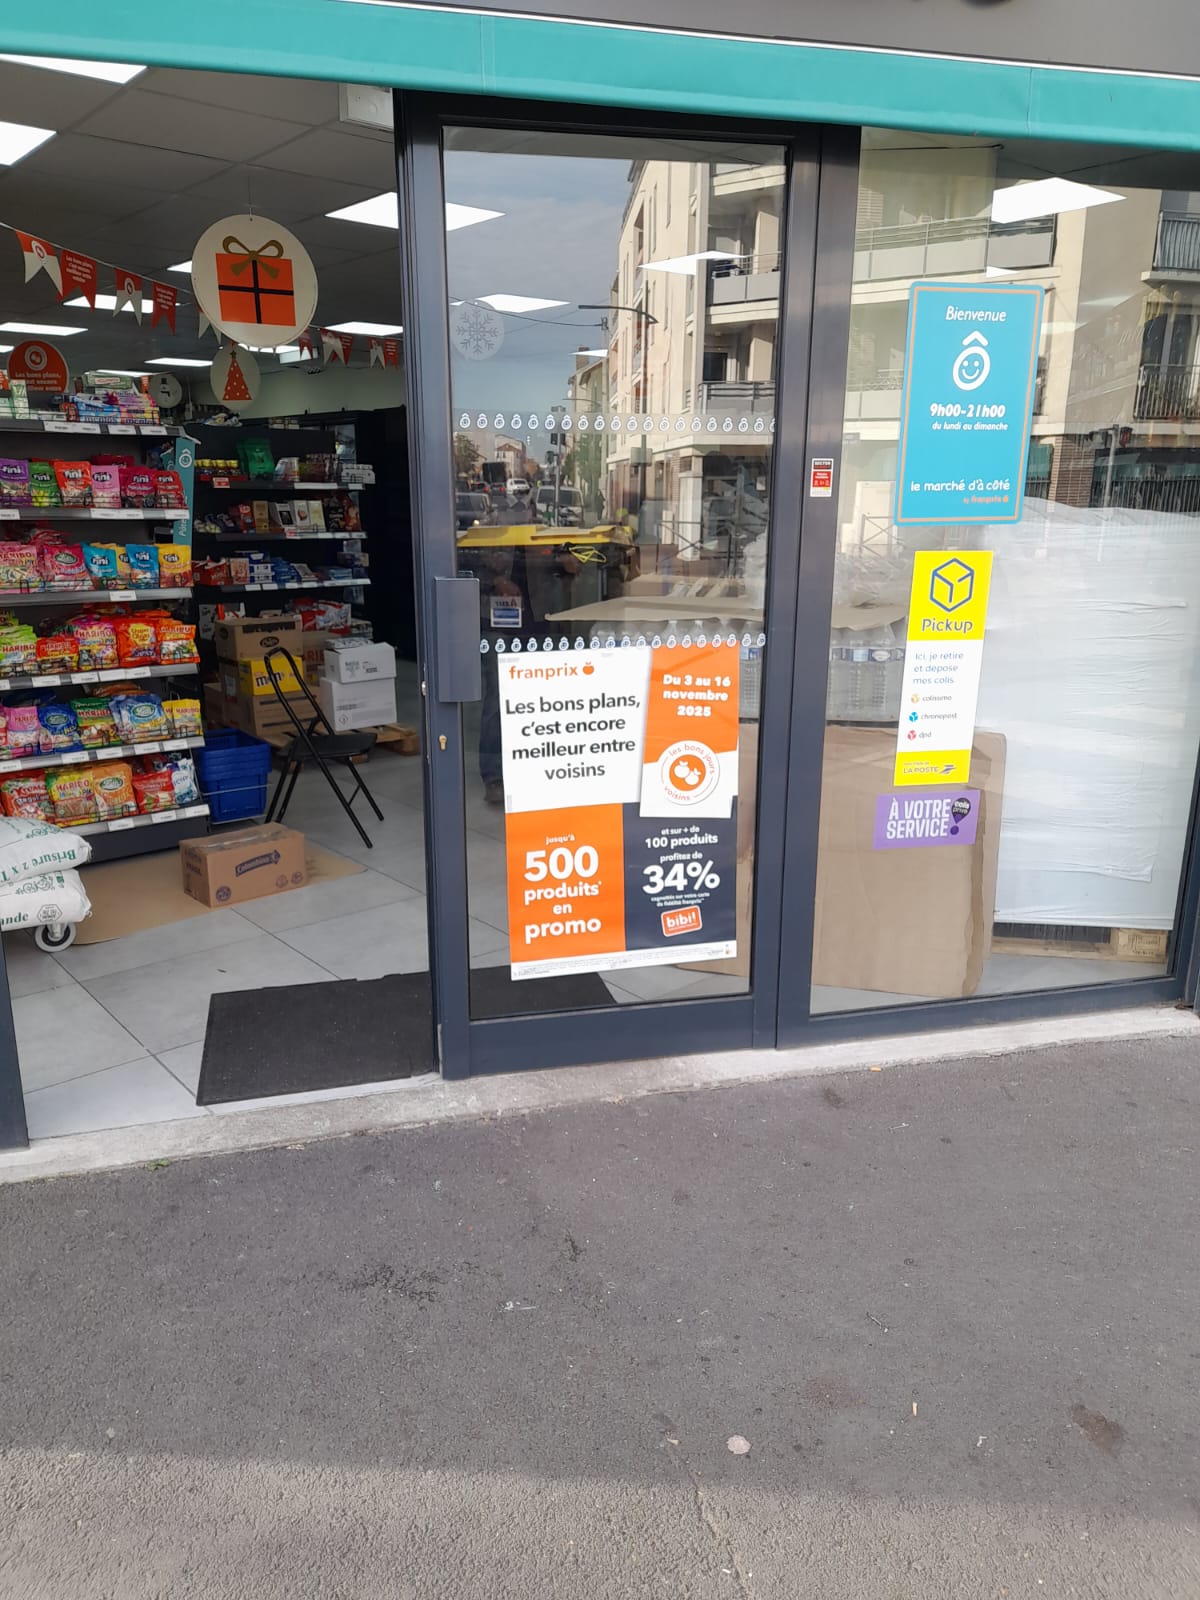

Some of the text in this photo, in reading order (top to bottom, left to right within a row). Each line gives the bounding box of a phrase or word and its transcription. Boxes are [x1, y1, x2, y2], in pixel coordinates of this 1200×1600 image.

[945, 306, 1006, 322] Bienvenue
[930, 403, 1006, 418] 9h00-21h00
[943, 422, 960, 430] lundi
[974, 422, 1008, 431] dimanche
[910, 479, 1010, 492] le marché d'à côté
[921, 618, 973, 633] Pickup
[928, 652, 937, 662] je
[939, 651, 964, 660] retire
[509, 662, 578, 680] franprix
[663, 675, 731, 687] Du 3 au 16
[663, 689, 728, 701] novembre
[506, 693, 640, 715] Les bons plans,
[677, 705, 711, 716] 2025
[521, 719, 626, 736] c'est encore
[918, 731, 932, 740] dpd
[512, 739, 636, 760] meilleur entre
[684, 743, 704, 755] bons
[544, 764, 605, 780] voisins
[888, 798, 951, 820] À VOTRE
[689, 825, 700, 833] de
[886, 818, 948, 839] SERVICE
[546, 834, 575, 845] jusqu'à
[645, 833, 718, 850] 100 produits
[33, 849, 76, 867] Brisure
[524, 846, 599, 882] 500
[660, 851, 702, 864] profitez de
[23, 861, 30, 871] 2
[642, 860, 720, 894] 34%
[553, 902, 572, 914] en
[666, 912, 696, 928] bibi!
[525, 918, 601, 944] promo
